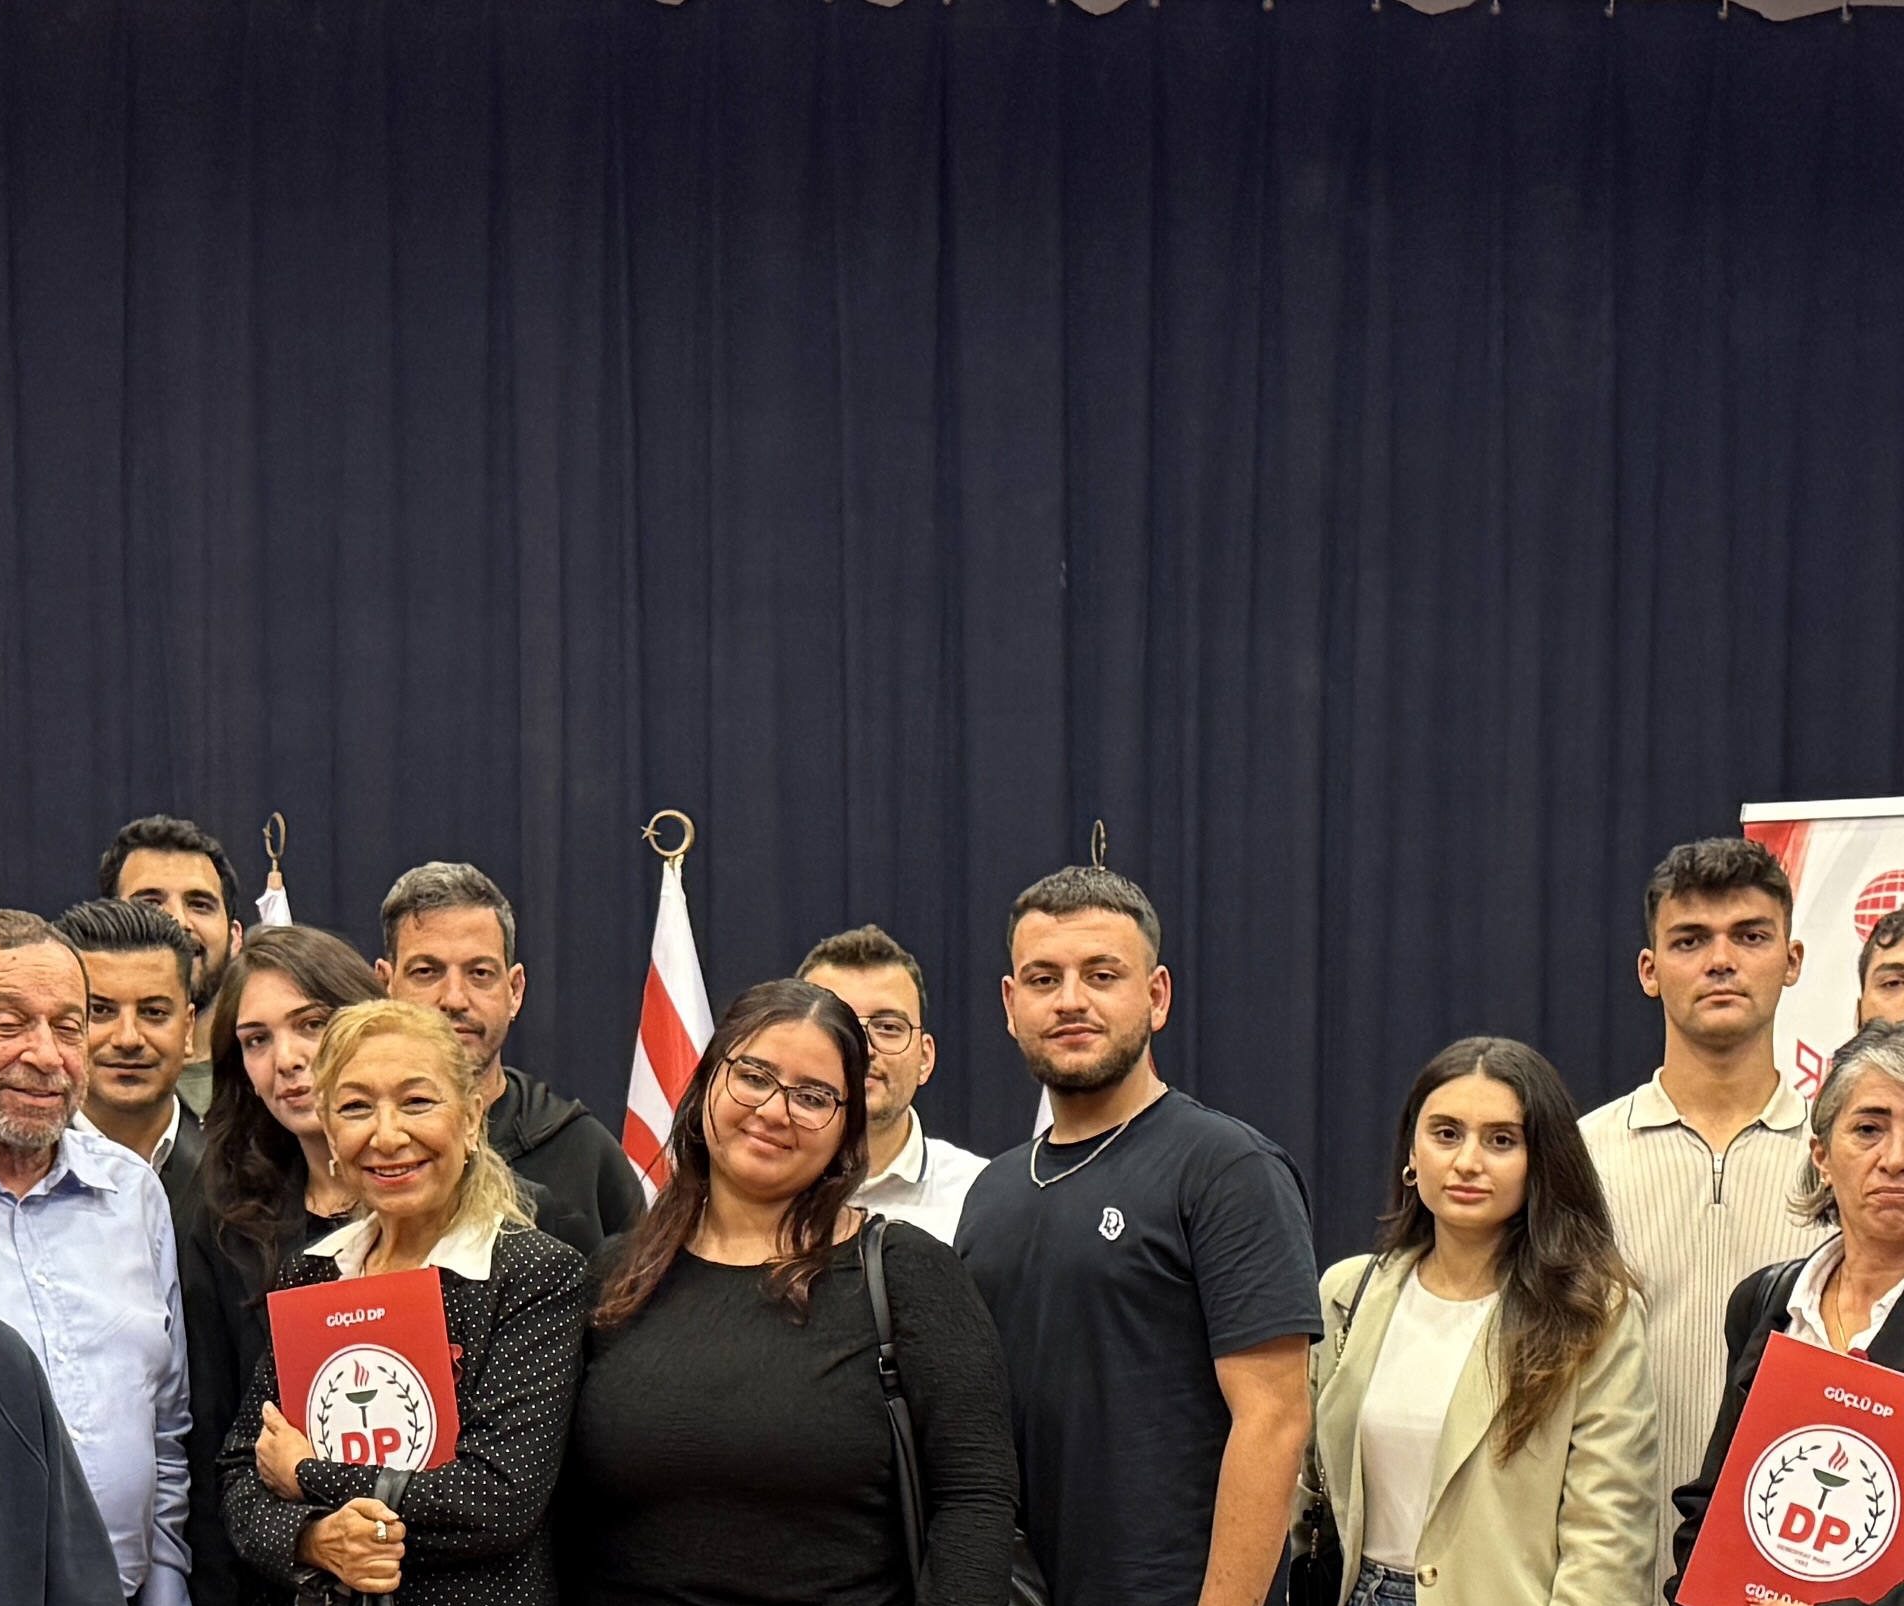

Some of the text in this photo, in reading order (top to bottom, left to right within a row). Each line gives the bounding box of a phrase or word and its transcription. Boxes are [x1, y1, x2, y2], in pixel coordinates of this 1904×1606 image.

[326, 1307, 386, 1328] GÜÇLÜ DP
[1823, 1386, 1894, 1418] GÜÇLÜ DP
[341, 1427, 402, 1467] DP
[1778, 1502, 1851, 1553] DP
